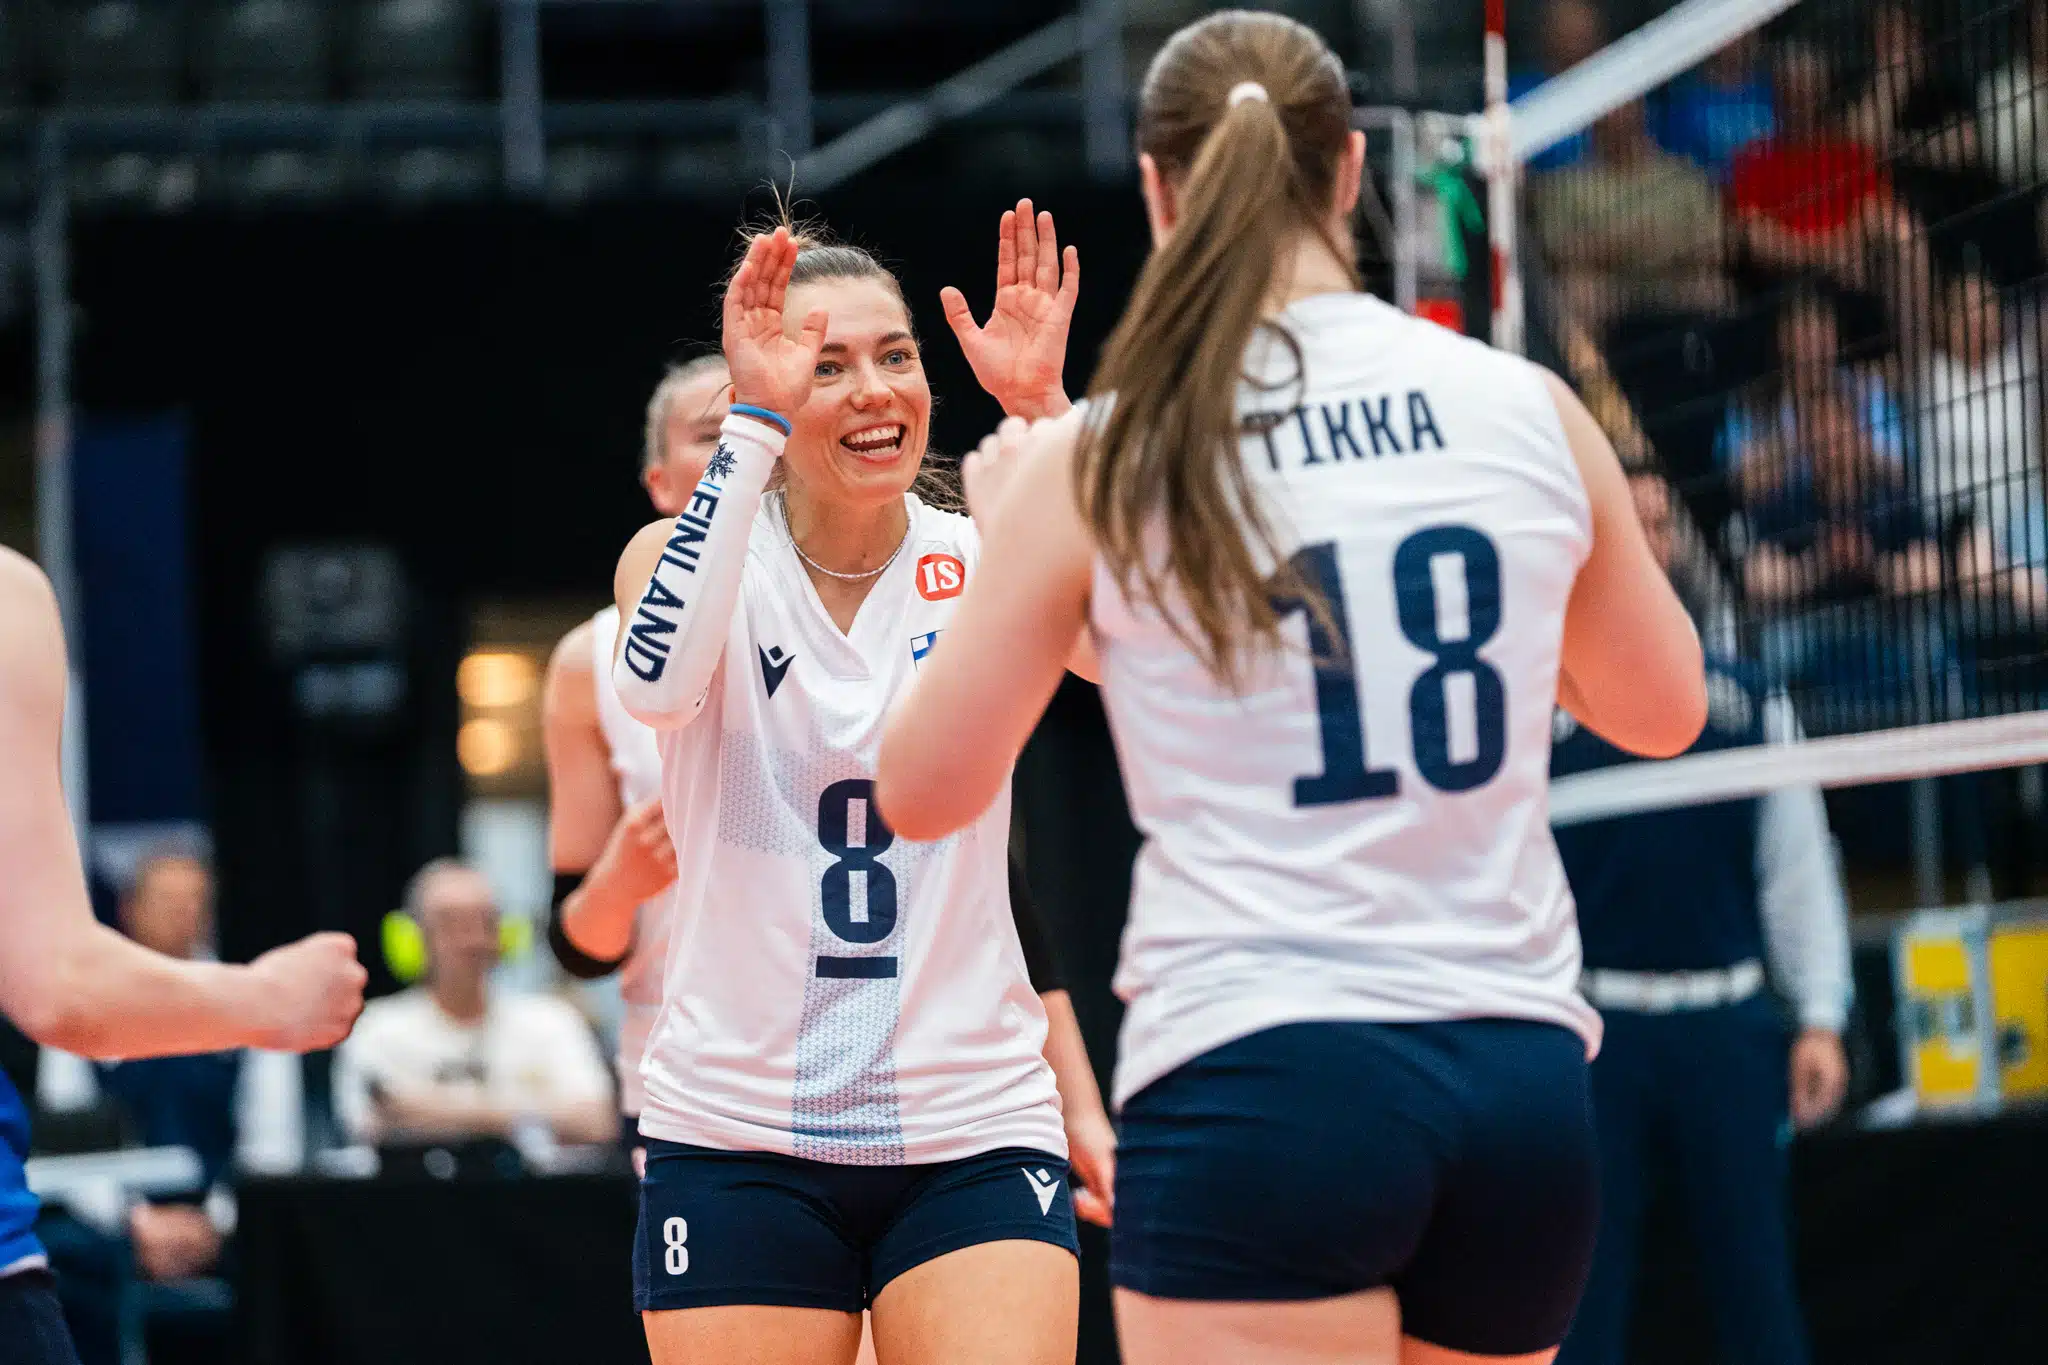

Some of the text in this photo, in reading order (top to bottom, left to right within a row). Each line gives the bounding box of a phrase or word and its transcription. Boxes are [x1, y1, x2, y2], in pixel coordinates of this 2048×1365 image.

[1240, 390, 1446, 472] TIKKA
[624, 489, 720, 684] FINLAND
[922, 561, 961, 593] IS
[1268, 523, 1508, 807] 18
[817, 778, 898, 944] 8
[663, 1216, 689, 1275] 8
